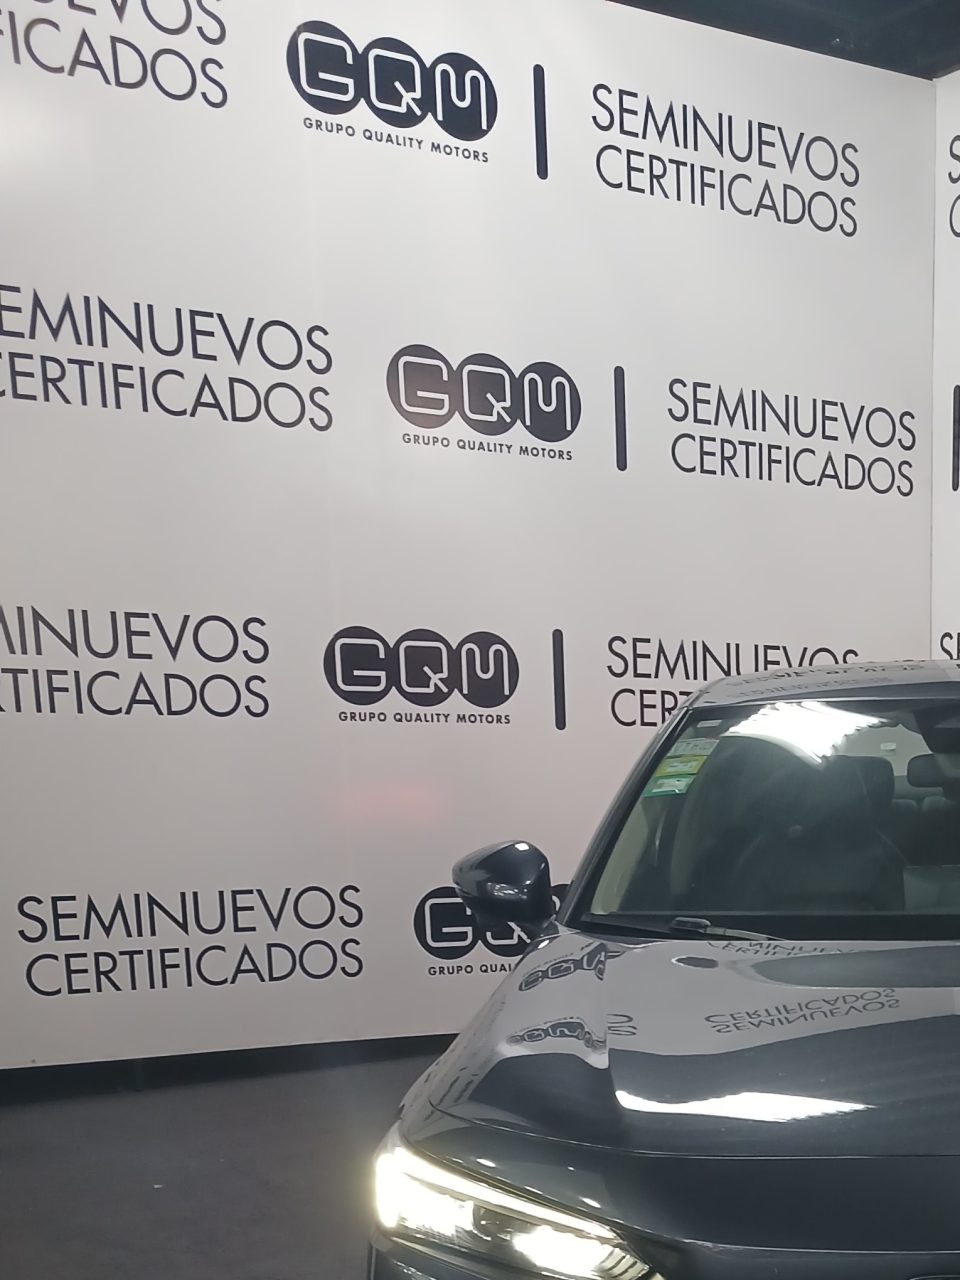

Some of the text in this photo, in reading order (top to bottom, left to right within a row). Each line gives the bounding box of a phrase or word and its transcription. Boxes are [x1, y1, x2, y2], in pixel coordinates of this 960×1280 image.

[0, 9, 228, 109] ICADOS
[286, 20, 498, 142] GQM
[303, 117, 489, 163] GRUPO QUALITY MOTORS
[592, 83, 860, 188] SEMINUEVOS
[596, 145, 858, 238] CERTIFICADOS
[0, 352, 333, 432] ERTIFICADOS
[386, 343, 582, 443] GQM
[668, 378, 917, 452] SEMINUEVOS
[402, 433, 573, 461] GRUPO QUALITY MOTORS
[671, 433, 914, 498] CERTIFICADOS
[0, 667, 270, 718] TIFICADOS
[322, 625, 520, 708] GQM
[338, 711, 511, 724] GRUPO QUALITY MOTORS
[17, 884, 364, 944] SEMINUEVOS
[26, 938, 364, 997] CERTIFICADOS
[428, 964, 474, 976] GRUPO
